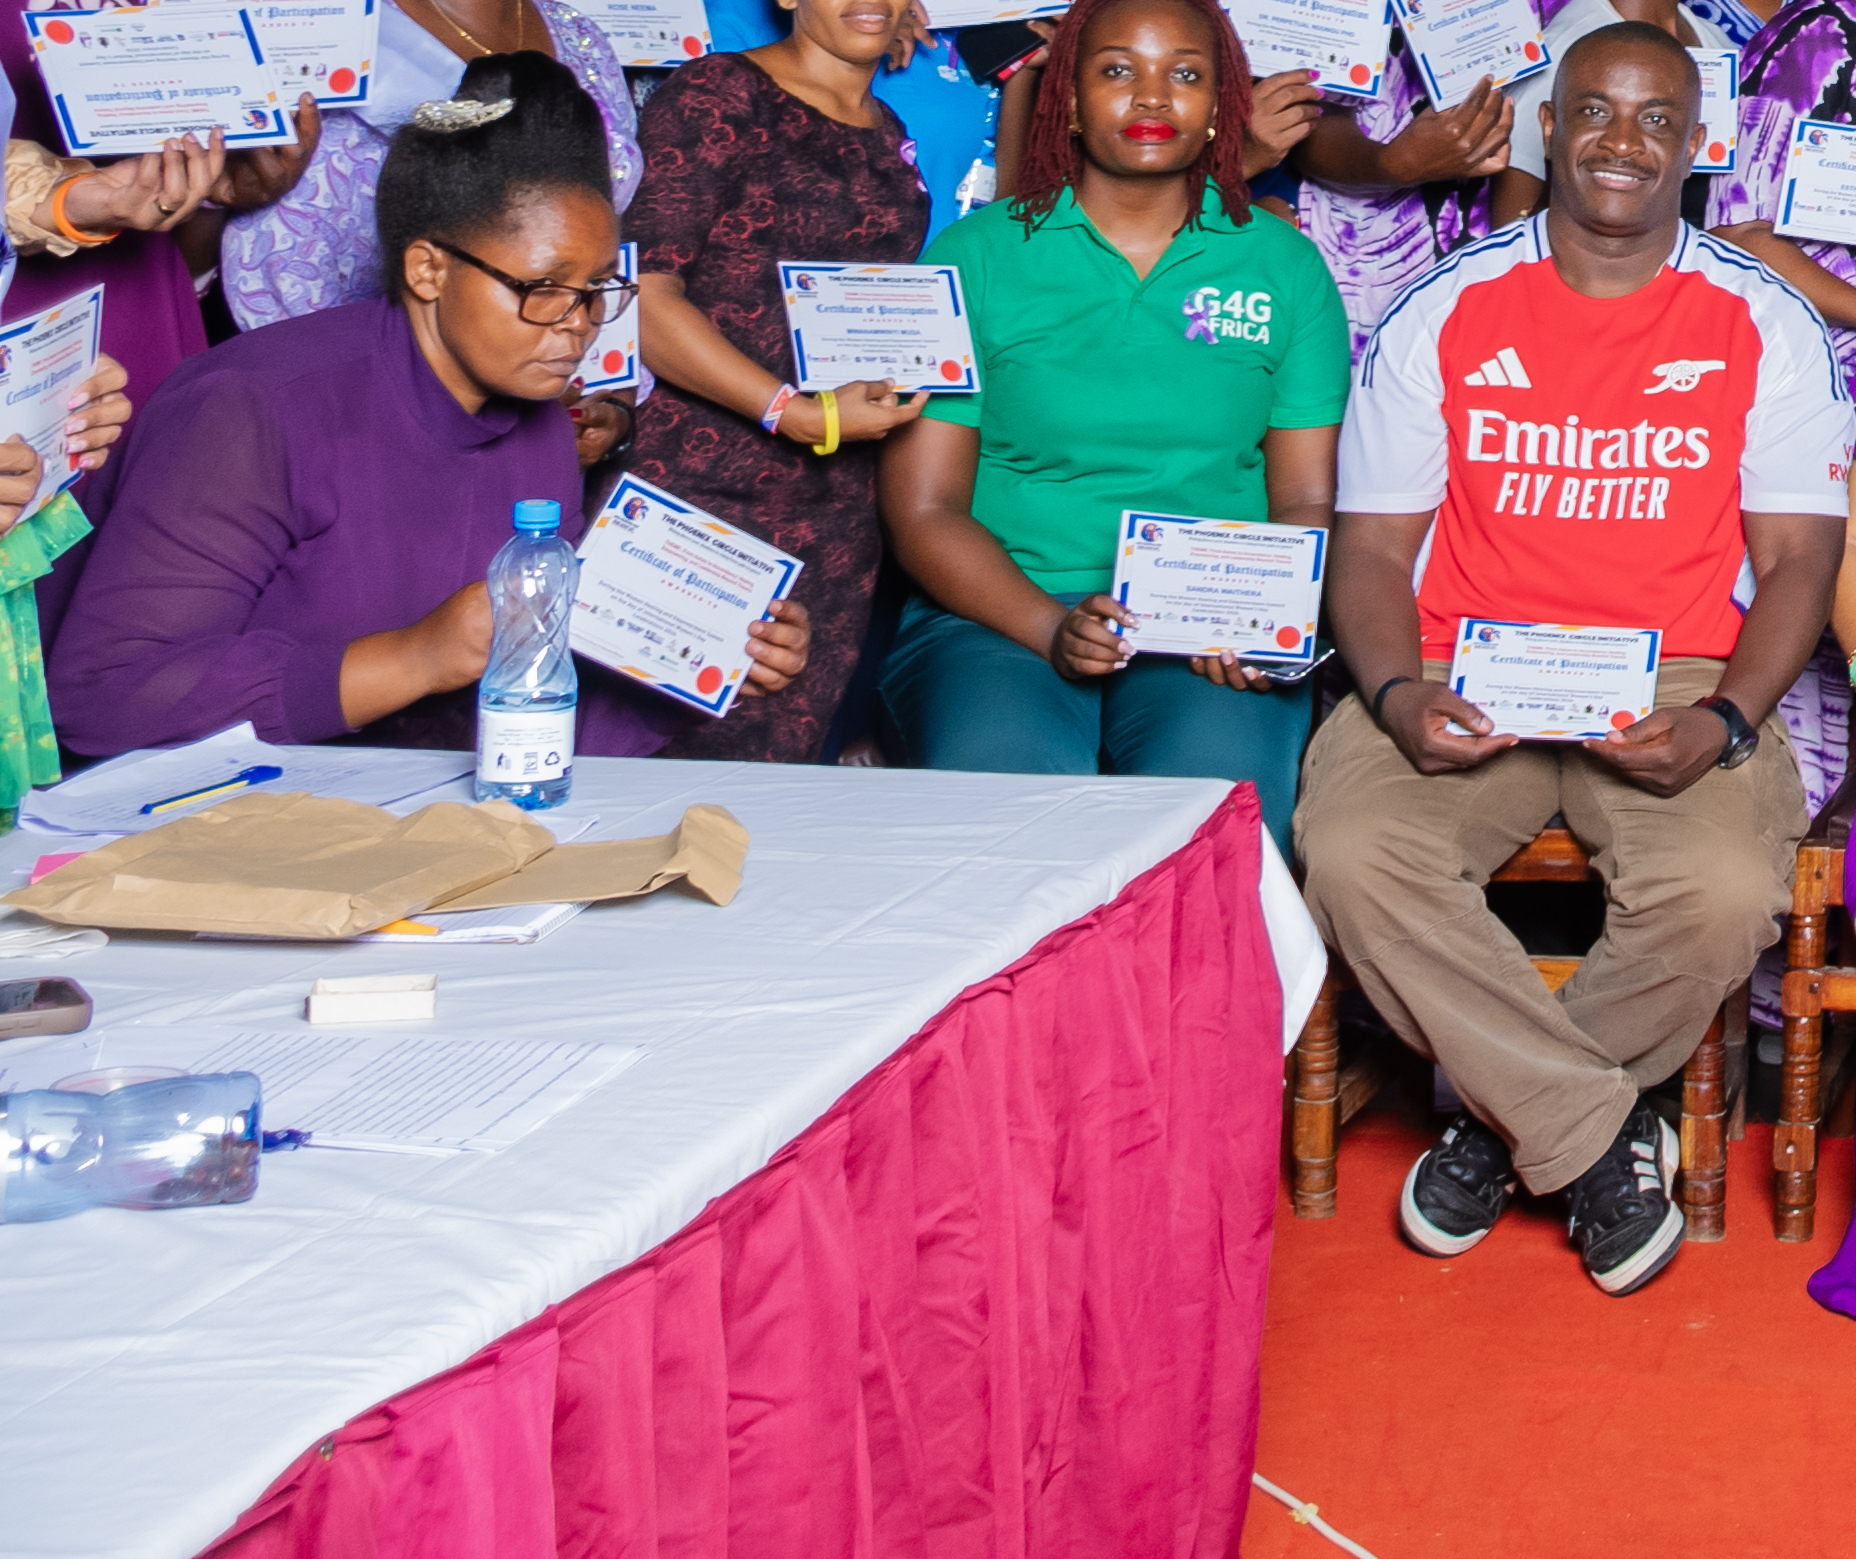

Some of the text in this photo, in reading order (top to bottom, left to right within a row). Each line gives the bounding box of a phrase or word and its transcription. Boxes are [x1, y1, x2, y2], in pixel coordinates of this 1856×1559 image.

[1194, 286, 1272, 323] G4G
[1466, 409, 1711, 470] Emirates
[1494, 471, 1671, 521] FLY BETTER
